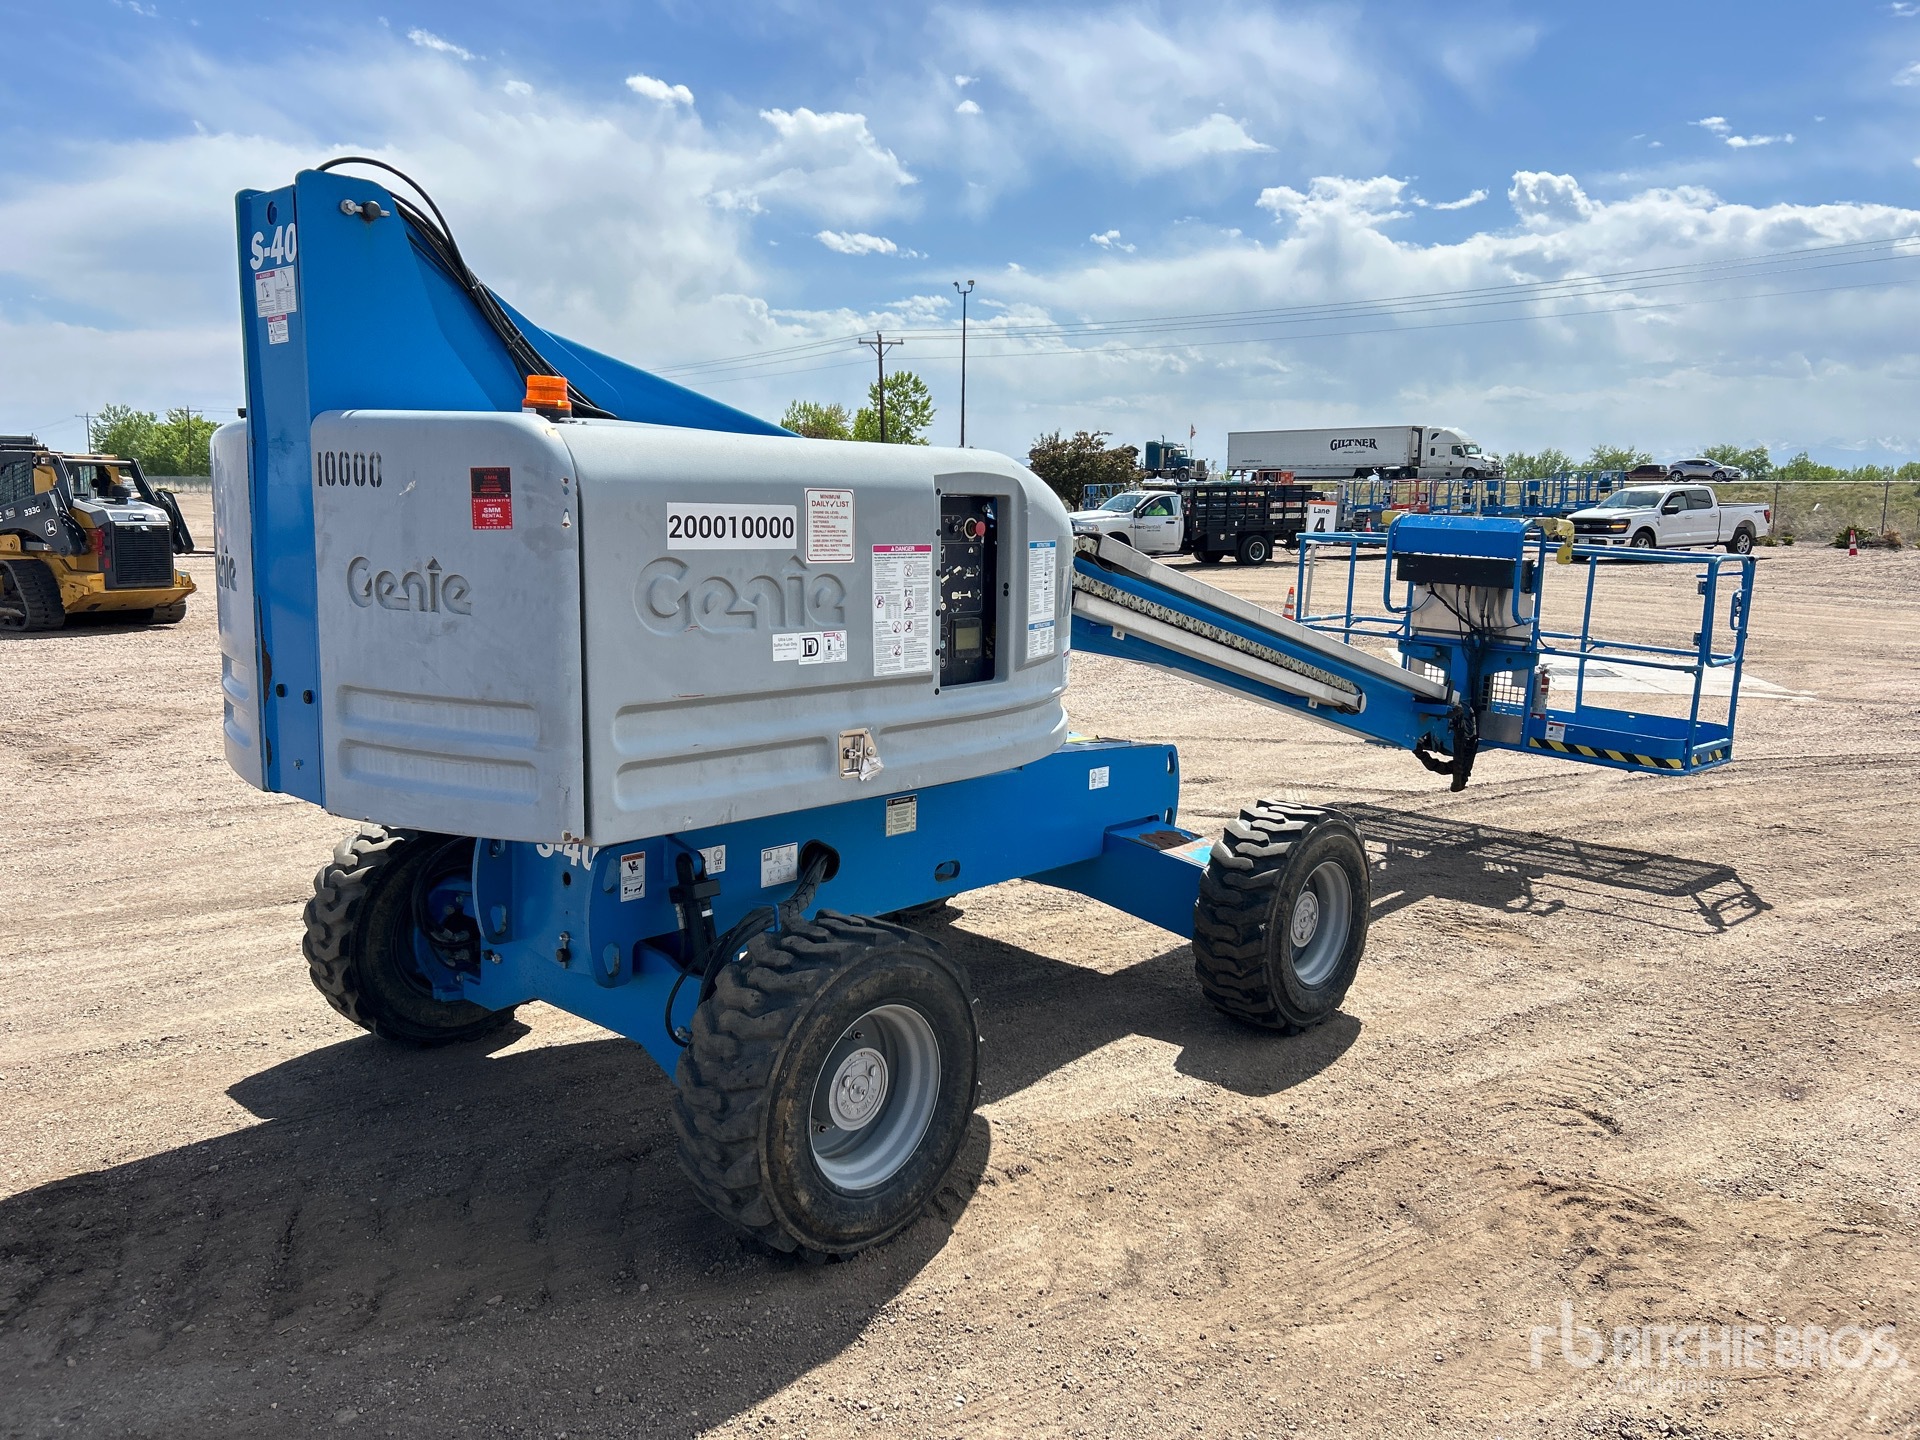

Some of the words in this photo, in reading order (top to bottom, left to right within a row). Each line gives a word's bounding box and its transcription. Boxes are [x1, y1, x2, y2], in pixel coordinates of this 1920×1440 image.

[250, 222, 298, 270] S-40
[1330, 438, 1378, 450] GILTNER
[317, 451, 383, 488] 10000
[23, 505, 41, 517] 333G
[811, 500, 829, 508] DAILY
[836, 500, 850, 508] LIST
[1313, 506, 1331, 515] Lane
[668, 514, 795, 539] 200010000
[1314, 517, 1326, 532] 4
[217, 545, 238, 592] enie
[347, 556, 472, 616] Genie
[633, 555, 847, 637] Genie
[802, 637, 819, 657] D
